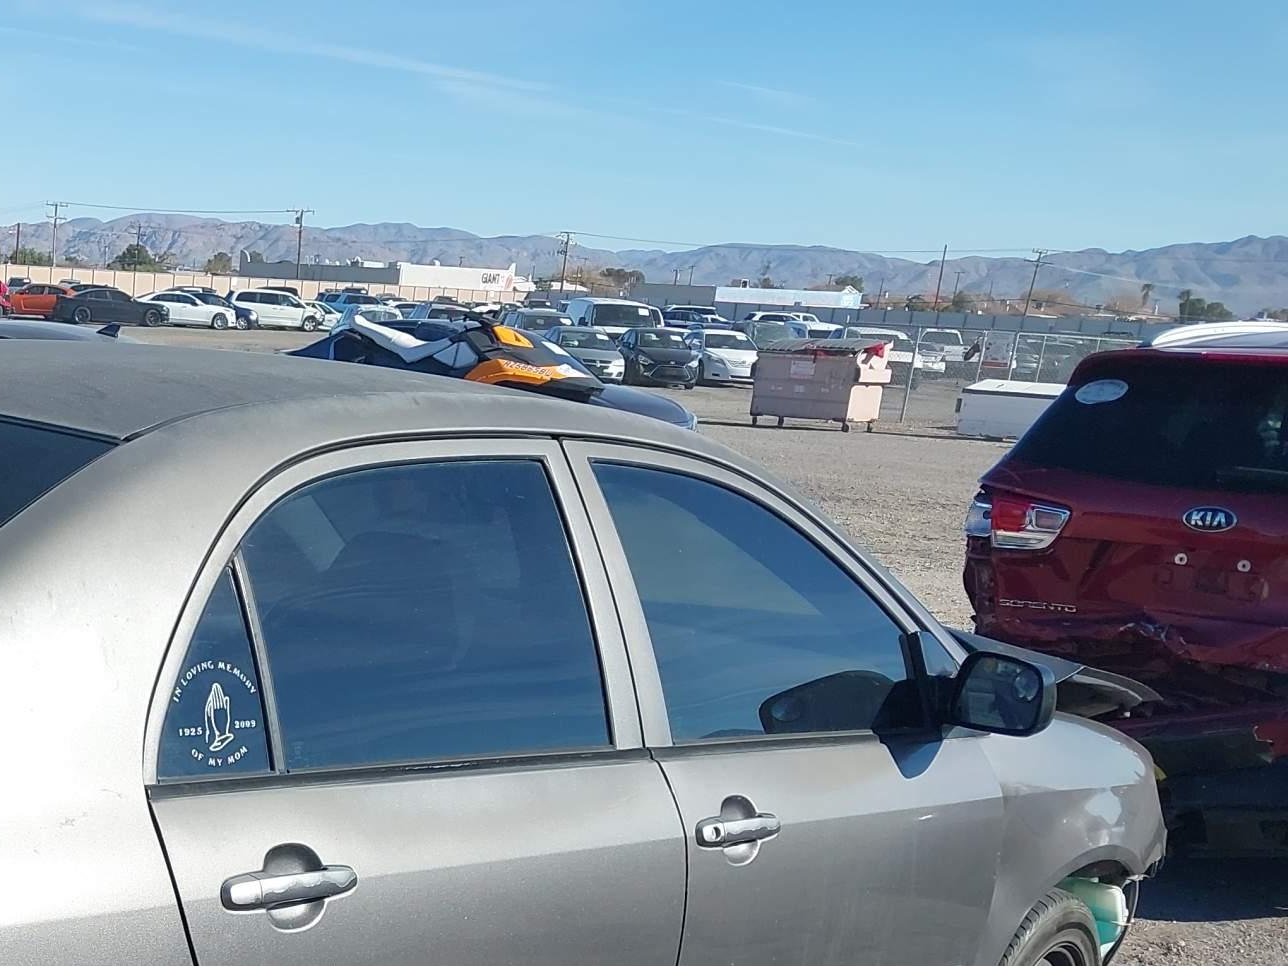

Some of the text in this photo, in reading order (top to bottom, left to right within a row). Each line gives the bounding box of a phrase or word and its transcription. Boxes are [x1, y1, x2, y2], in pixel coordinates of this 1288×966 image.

[481, 272, 501, 284] GIANT
[1190, 511, 1227, 527] KIA
[173, 661, 257, 702] IN LOVING MEMORY
[191, 745, 248, 767] OF MY MOM
